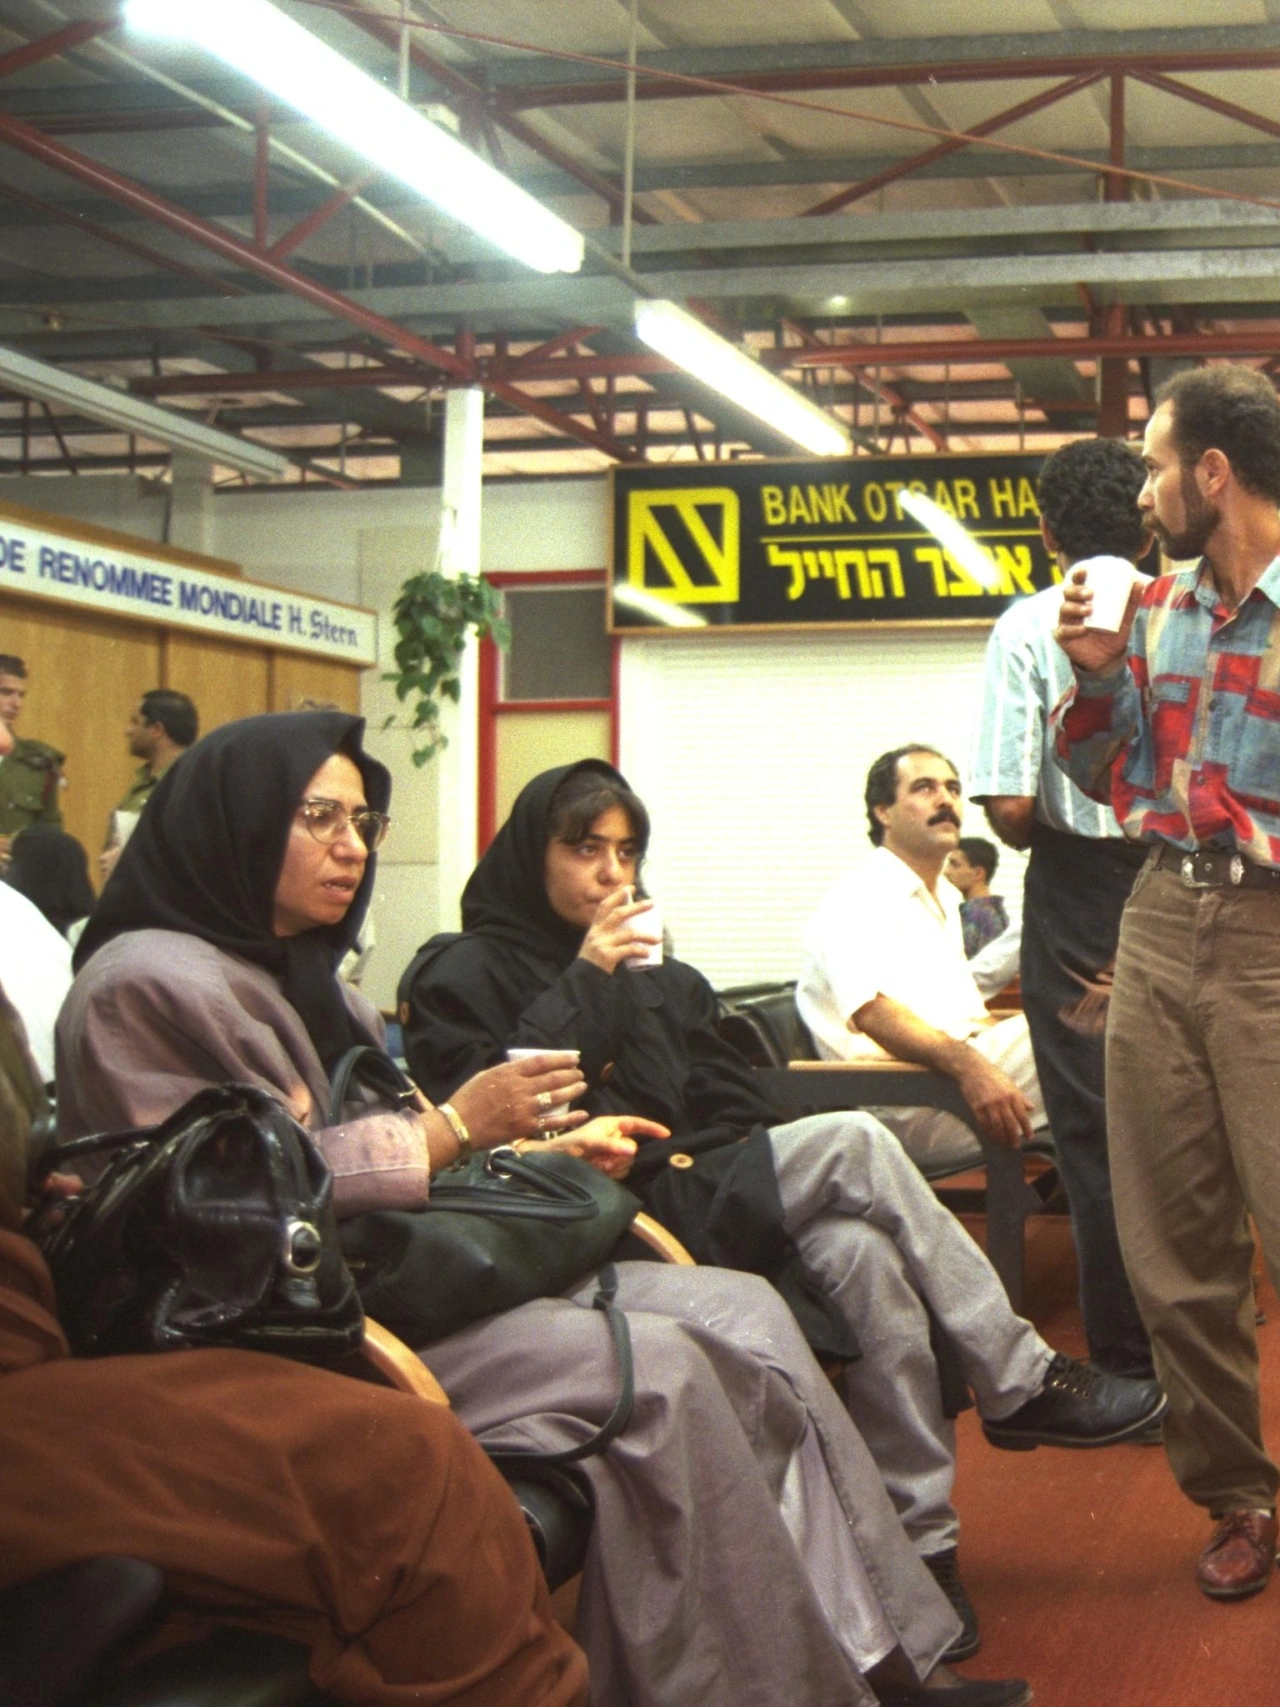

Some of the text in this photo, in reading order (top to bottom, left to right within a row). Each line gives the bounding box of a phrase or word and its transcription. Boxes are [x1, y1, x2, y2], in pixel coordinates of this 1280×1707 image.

[760, 482, 857, 526] BANK
[39, 545, 173, 606] RENOMMEE
[179, 580, 282, 632] MONDIALE
[310, 609, 359, 648] Stern
[767, 541, 905, 600] החייל
